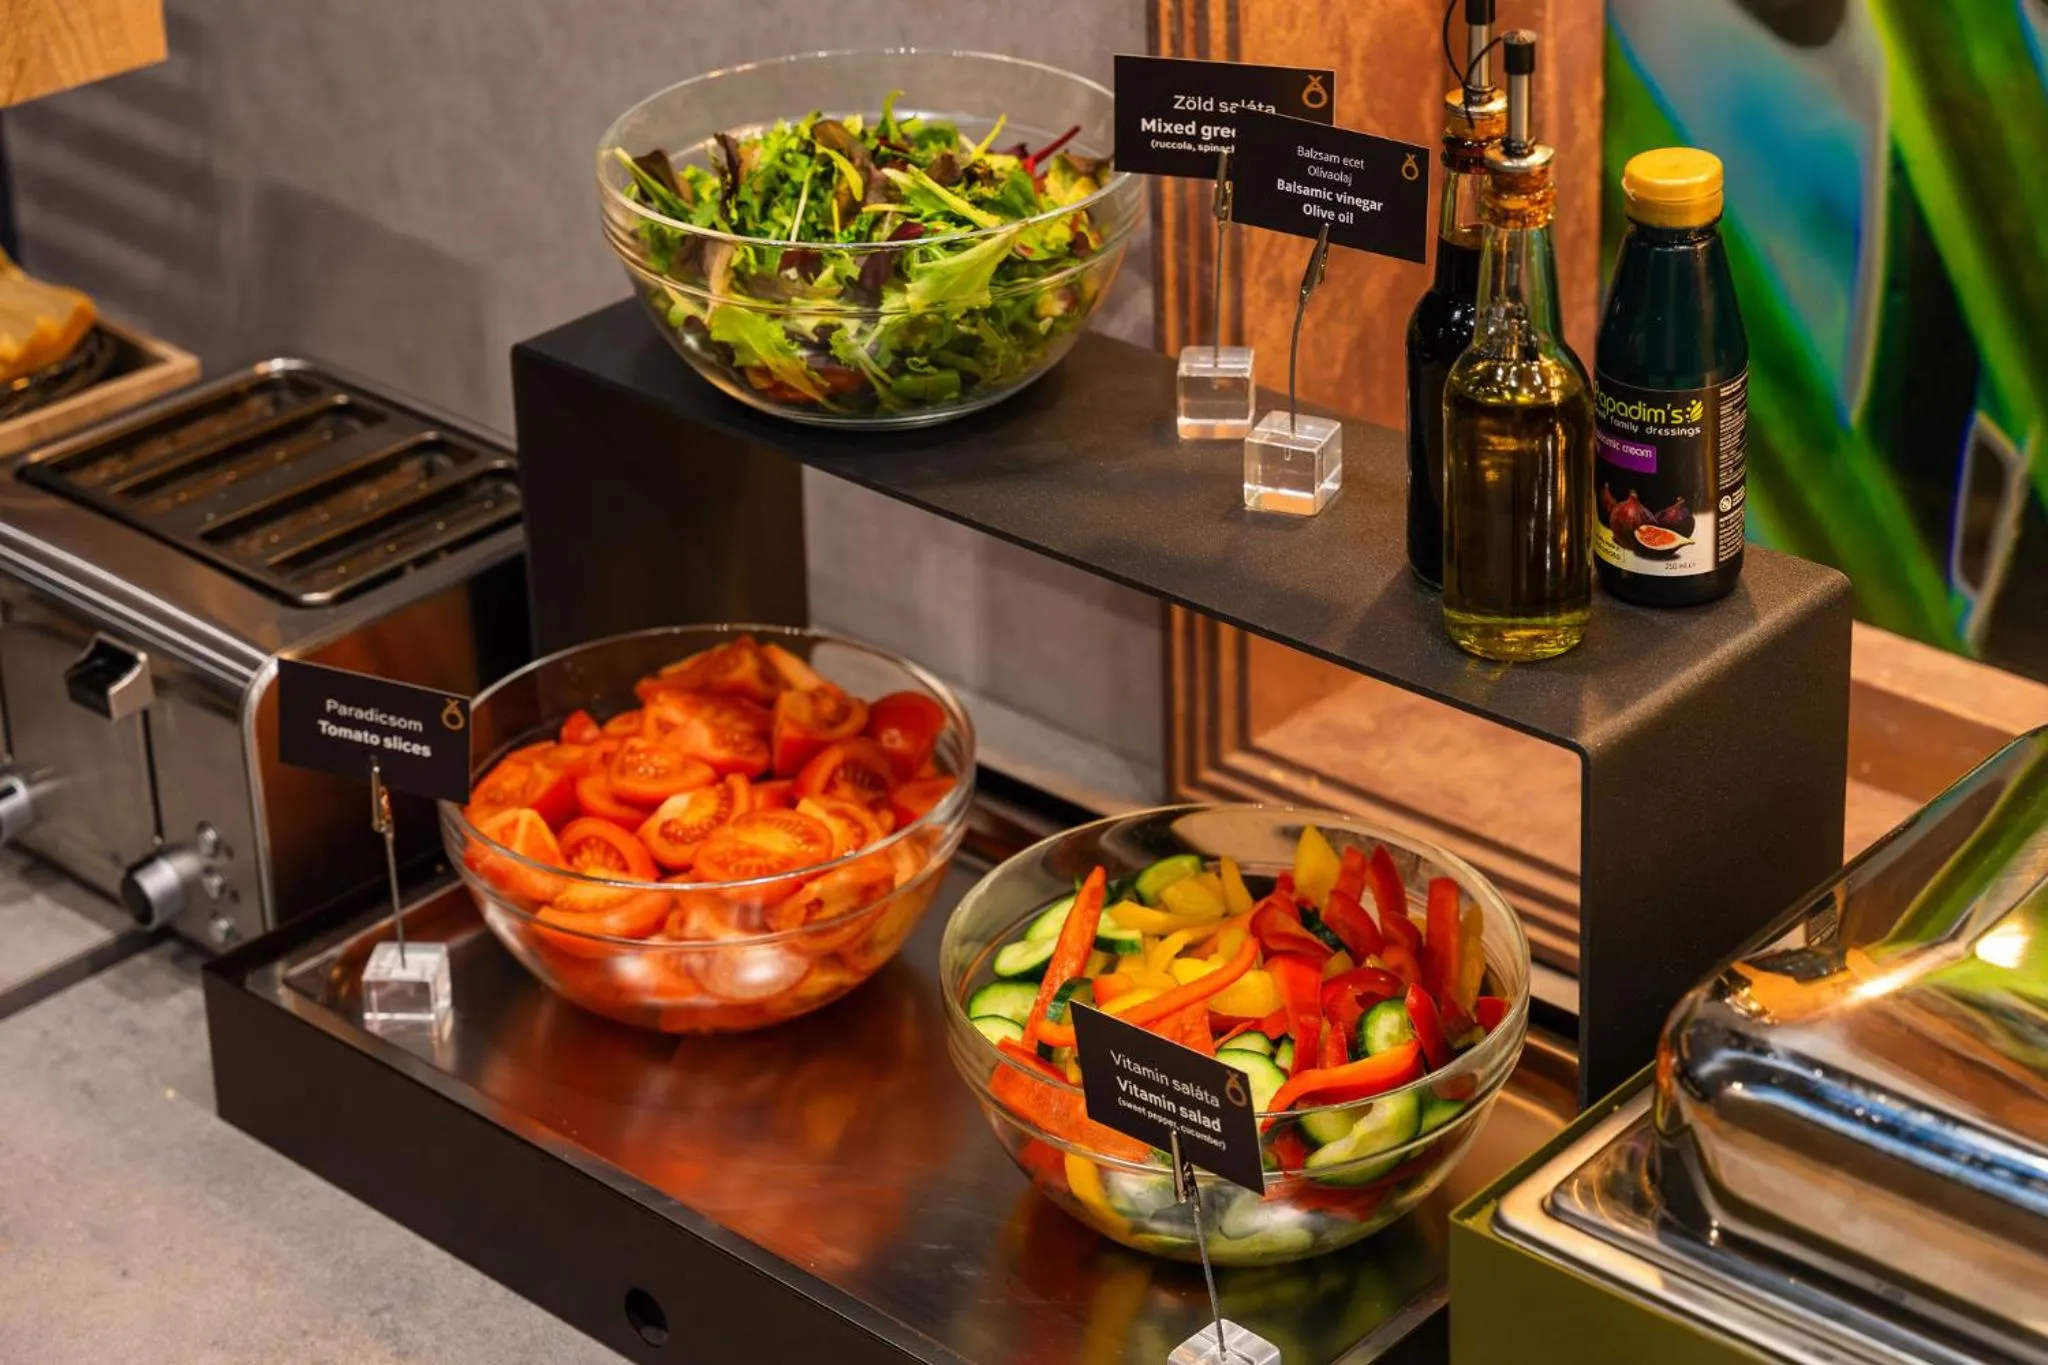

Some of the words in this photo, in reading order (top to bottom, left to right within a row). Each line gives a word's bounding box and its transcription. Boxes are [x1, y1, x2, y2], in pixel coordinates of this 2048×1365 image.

[1173, 95, 1214, 112] Zöld
[1141, 118, 1196, 136] Mixed
[1150, 139, 1196, 151] (ruccola,
[1297, 145, 1340, 164] Balzsam
[1343, 156, 1365, 170] ecet
[1308, 165, 1352, 187] Olivaolaj
[1277, 178, 1333, 201] Balsamic
[1336, 192, 1383, 212] vinegar
[1303, 203, 1335, 221] Olive
[1338, 212, 1354, 225] oil
[1645, 425, 1701, 437] dressings
[1622, 444, 1653, 458] cream
[325, 698, 423, 732] Paradicsom
[317, 719, 380, 746] Tomato
[382, 735, 432, 758] slices
[1110, 1049, 1169, 1087] Vitamin
[1172, 1078, 1220, 1108] saláta
[1116, 1076, 1176, 1113] Vitamin
[1179, 1105, 1222, 1132] salad
[1118, 1096, 1147, 1116] (sweet
